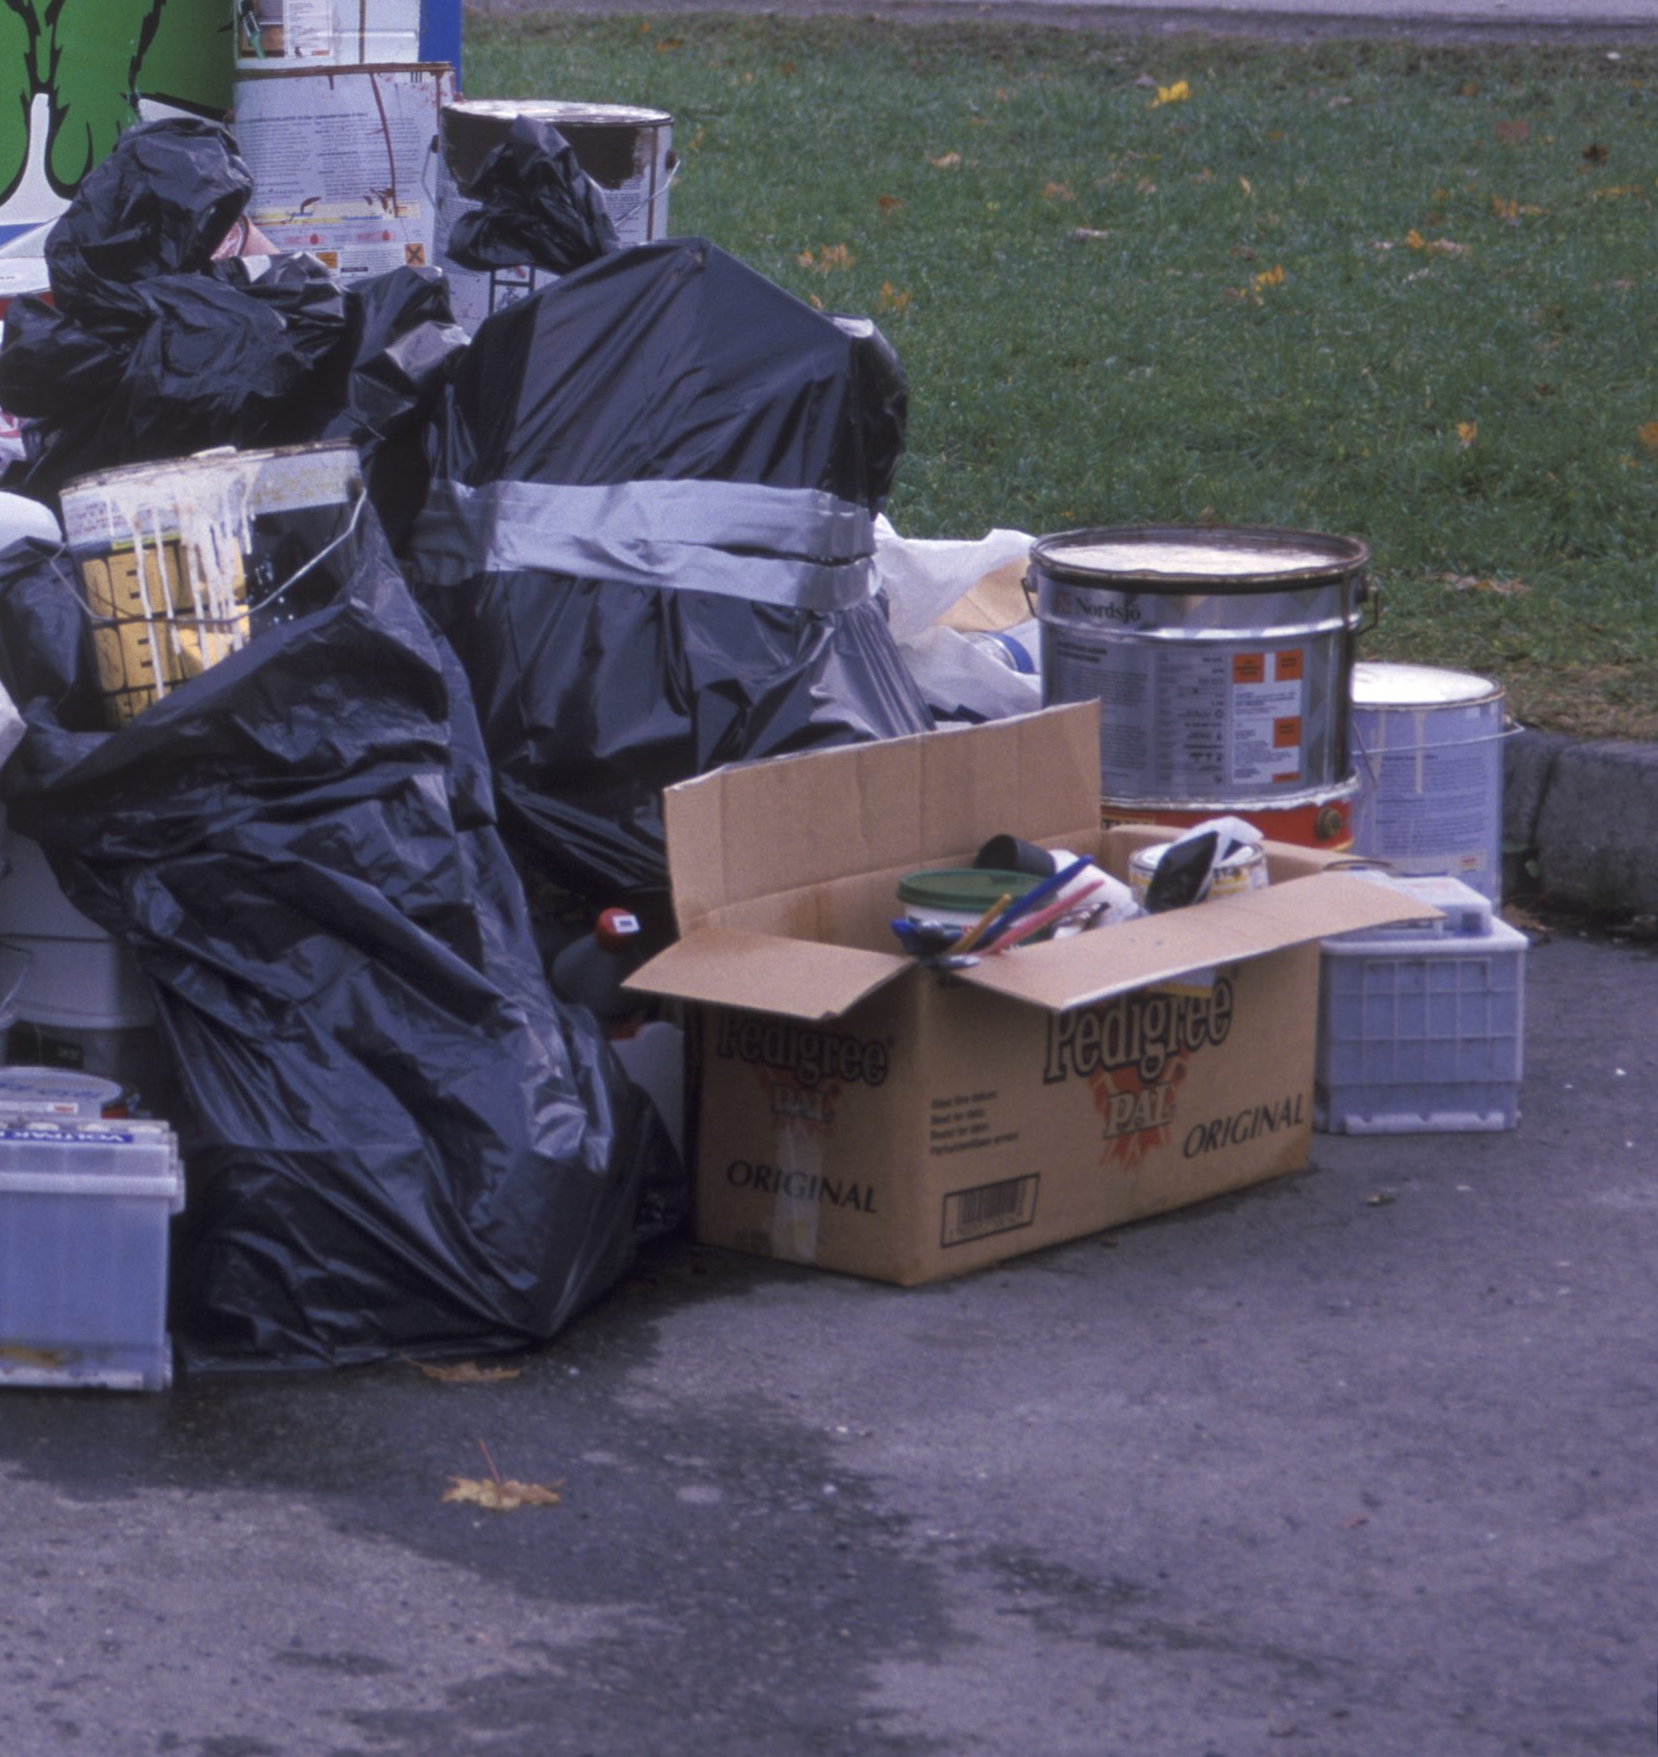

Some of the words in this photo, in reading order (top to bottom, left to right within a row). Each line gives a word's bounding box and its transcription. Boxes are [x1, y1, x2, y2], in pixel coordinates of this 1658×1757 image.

[1042, 977, 1234, 1084] Pedigree
[1103, 1083, 1176, 1141] PAL
[1183, 1092, 1305, 1159] ORIGINAL
[726, 1159, 878, 1214] ORIGINAL
